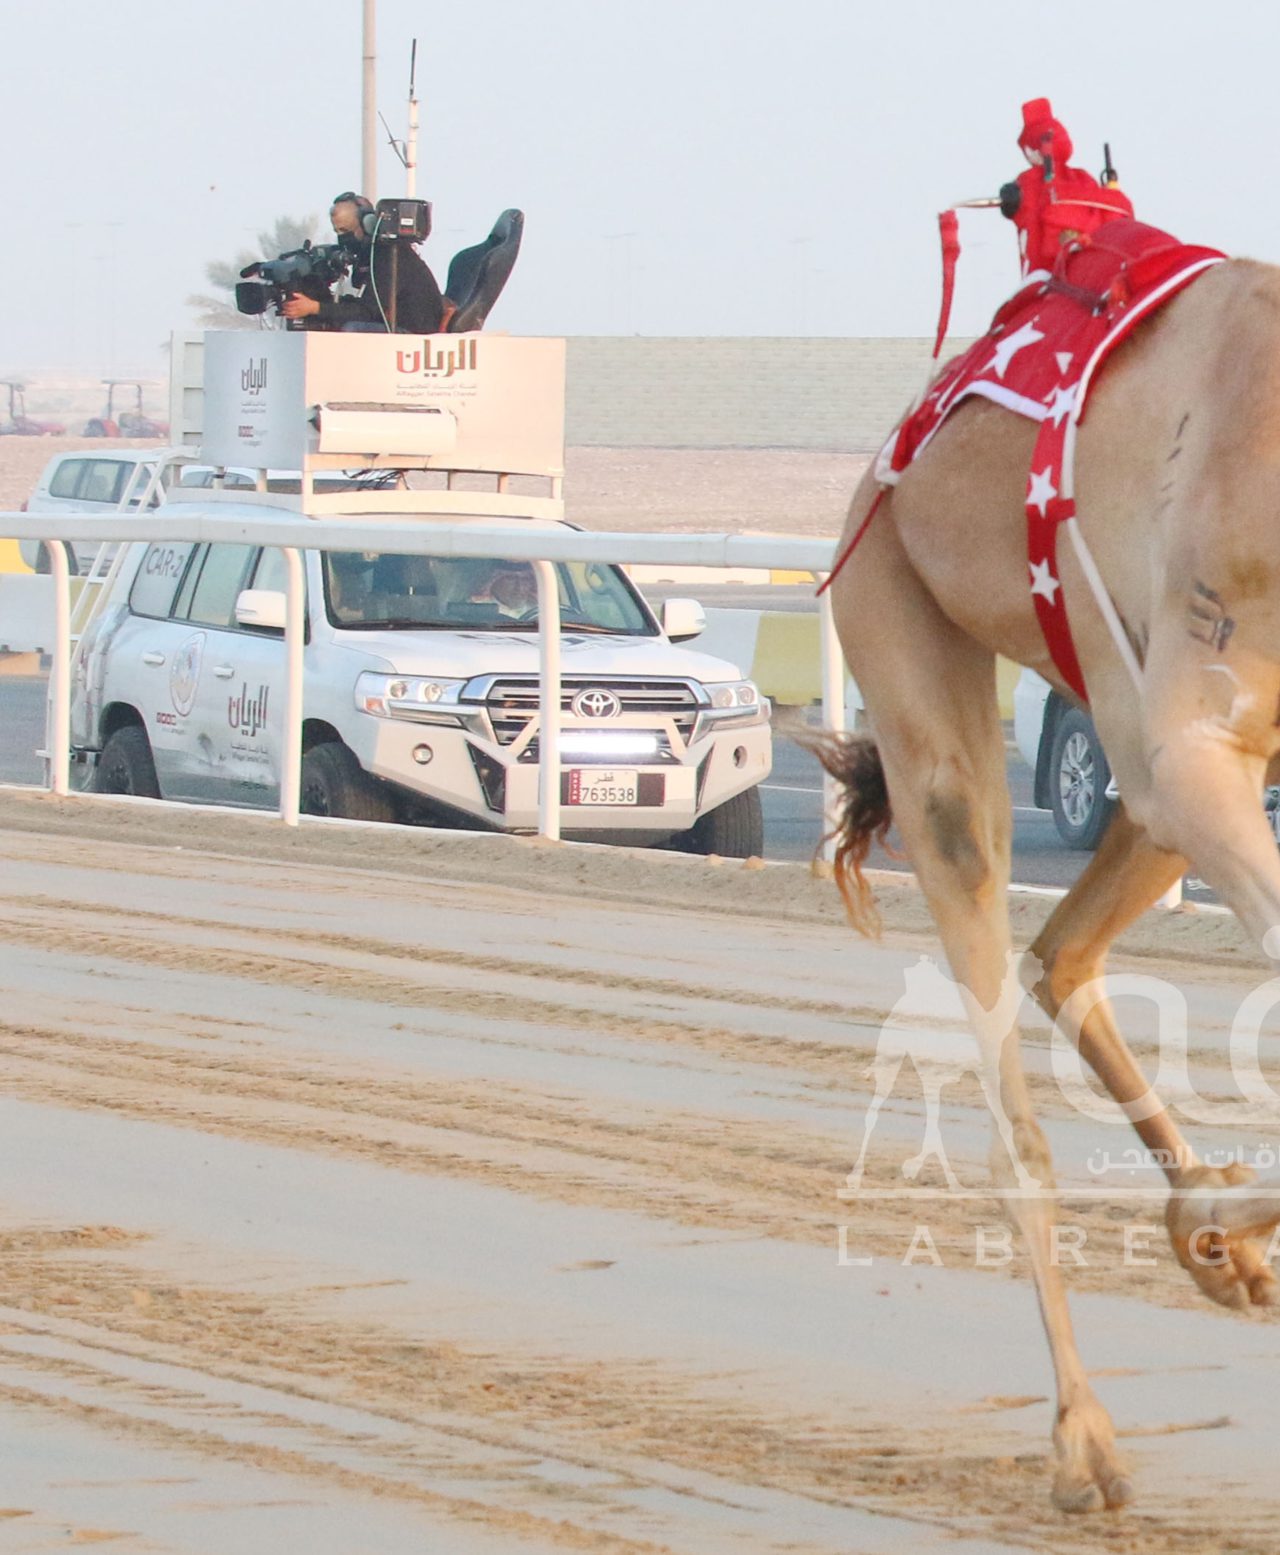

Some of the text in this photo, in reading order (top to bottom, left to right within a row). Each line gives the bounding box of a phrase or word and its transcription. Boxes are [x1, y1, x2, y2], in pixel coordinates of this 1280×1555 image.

[241, 357, 267, 395] الريان
[396, 339, 477, 377] الريان
[228, 682, 269, 737] الريان
[581, 787, 635, 802] 763538
[594, 771, 615, 784] قطر
